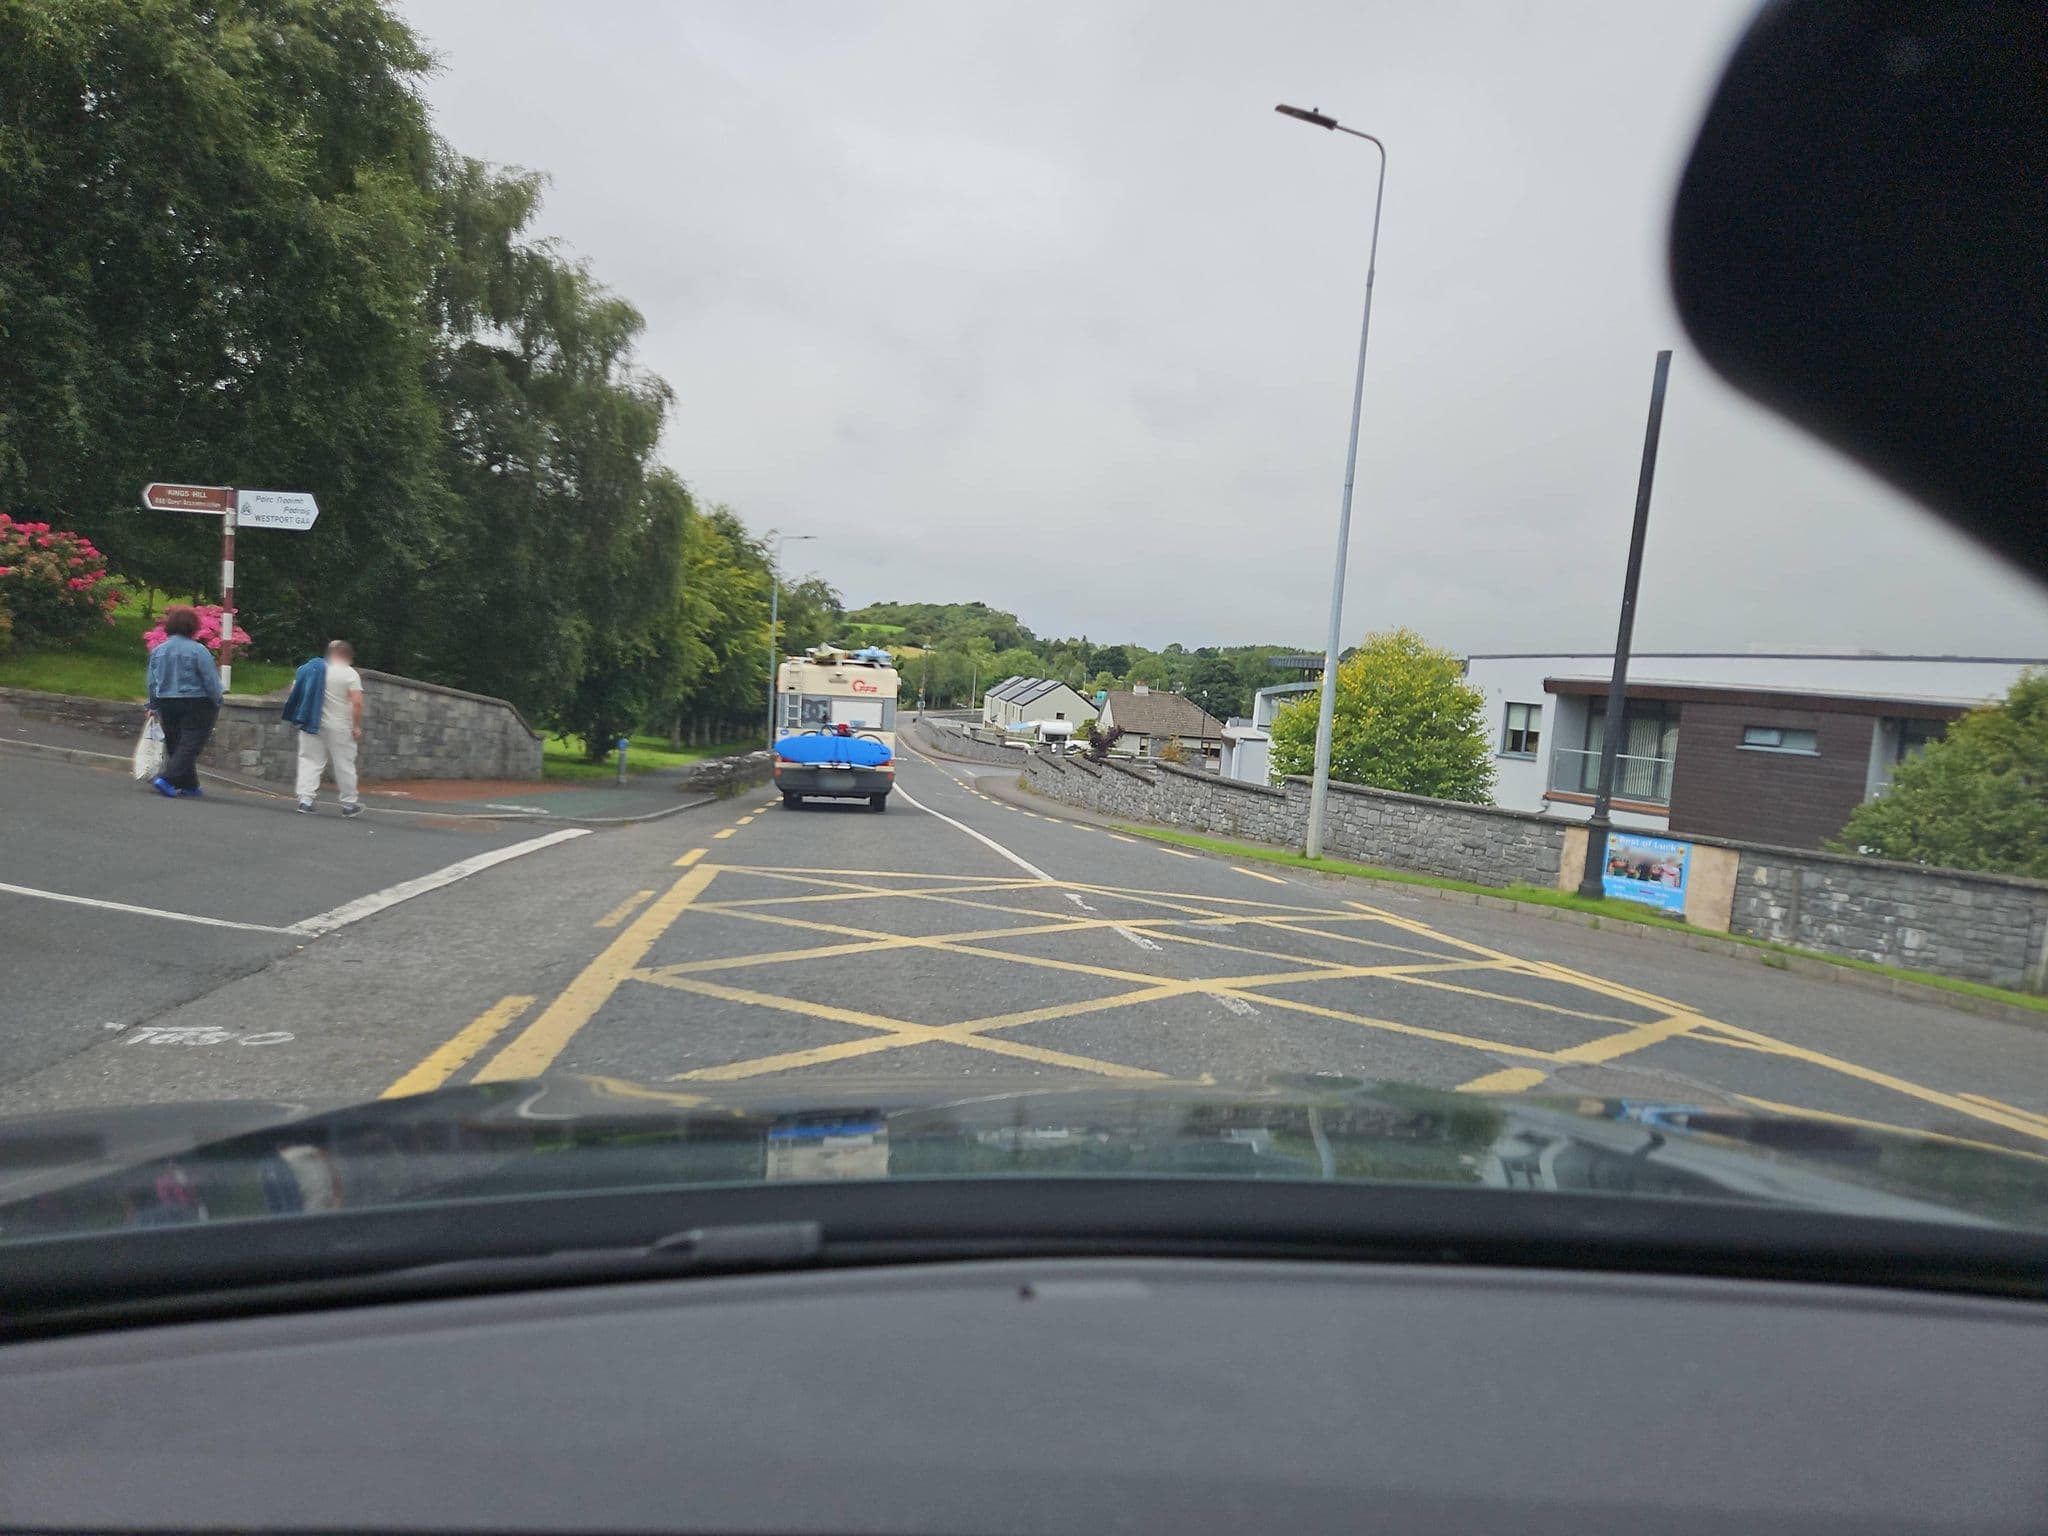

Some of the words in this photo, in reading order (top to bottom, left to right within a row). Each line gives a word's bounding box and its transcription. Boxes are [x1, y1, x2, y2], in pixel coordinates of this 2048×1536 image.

[168, 489, 190, 497] KINGS
[255, 514, 294, 524] WESTPORT
[295, 516, 311, 525] GAA
[1642, 838, 1653, 848] of
[1655, 841, 1678, 852] Luck
